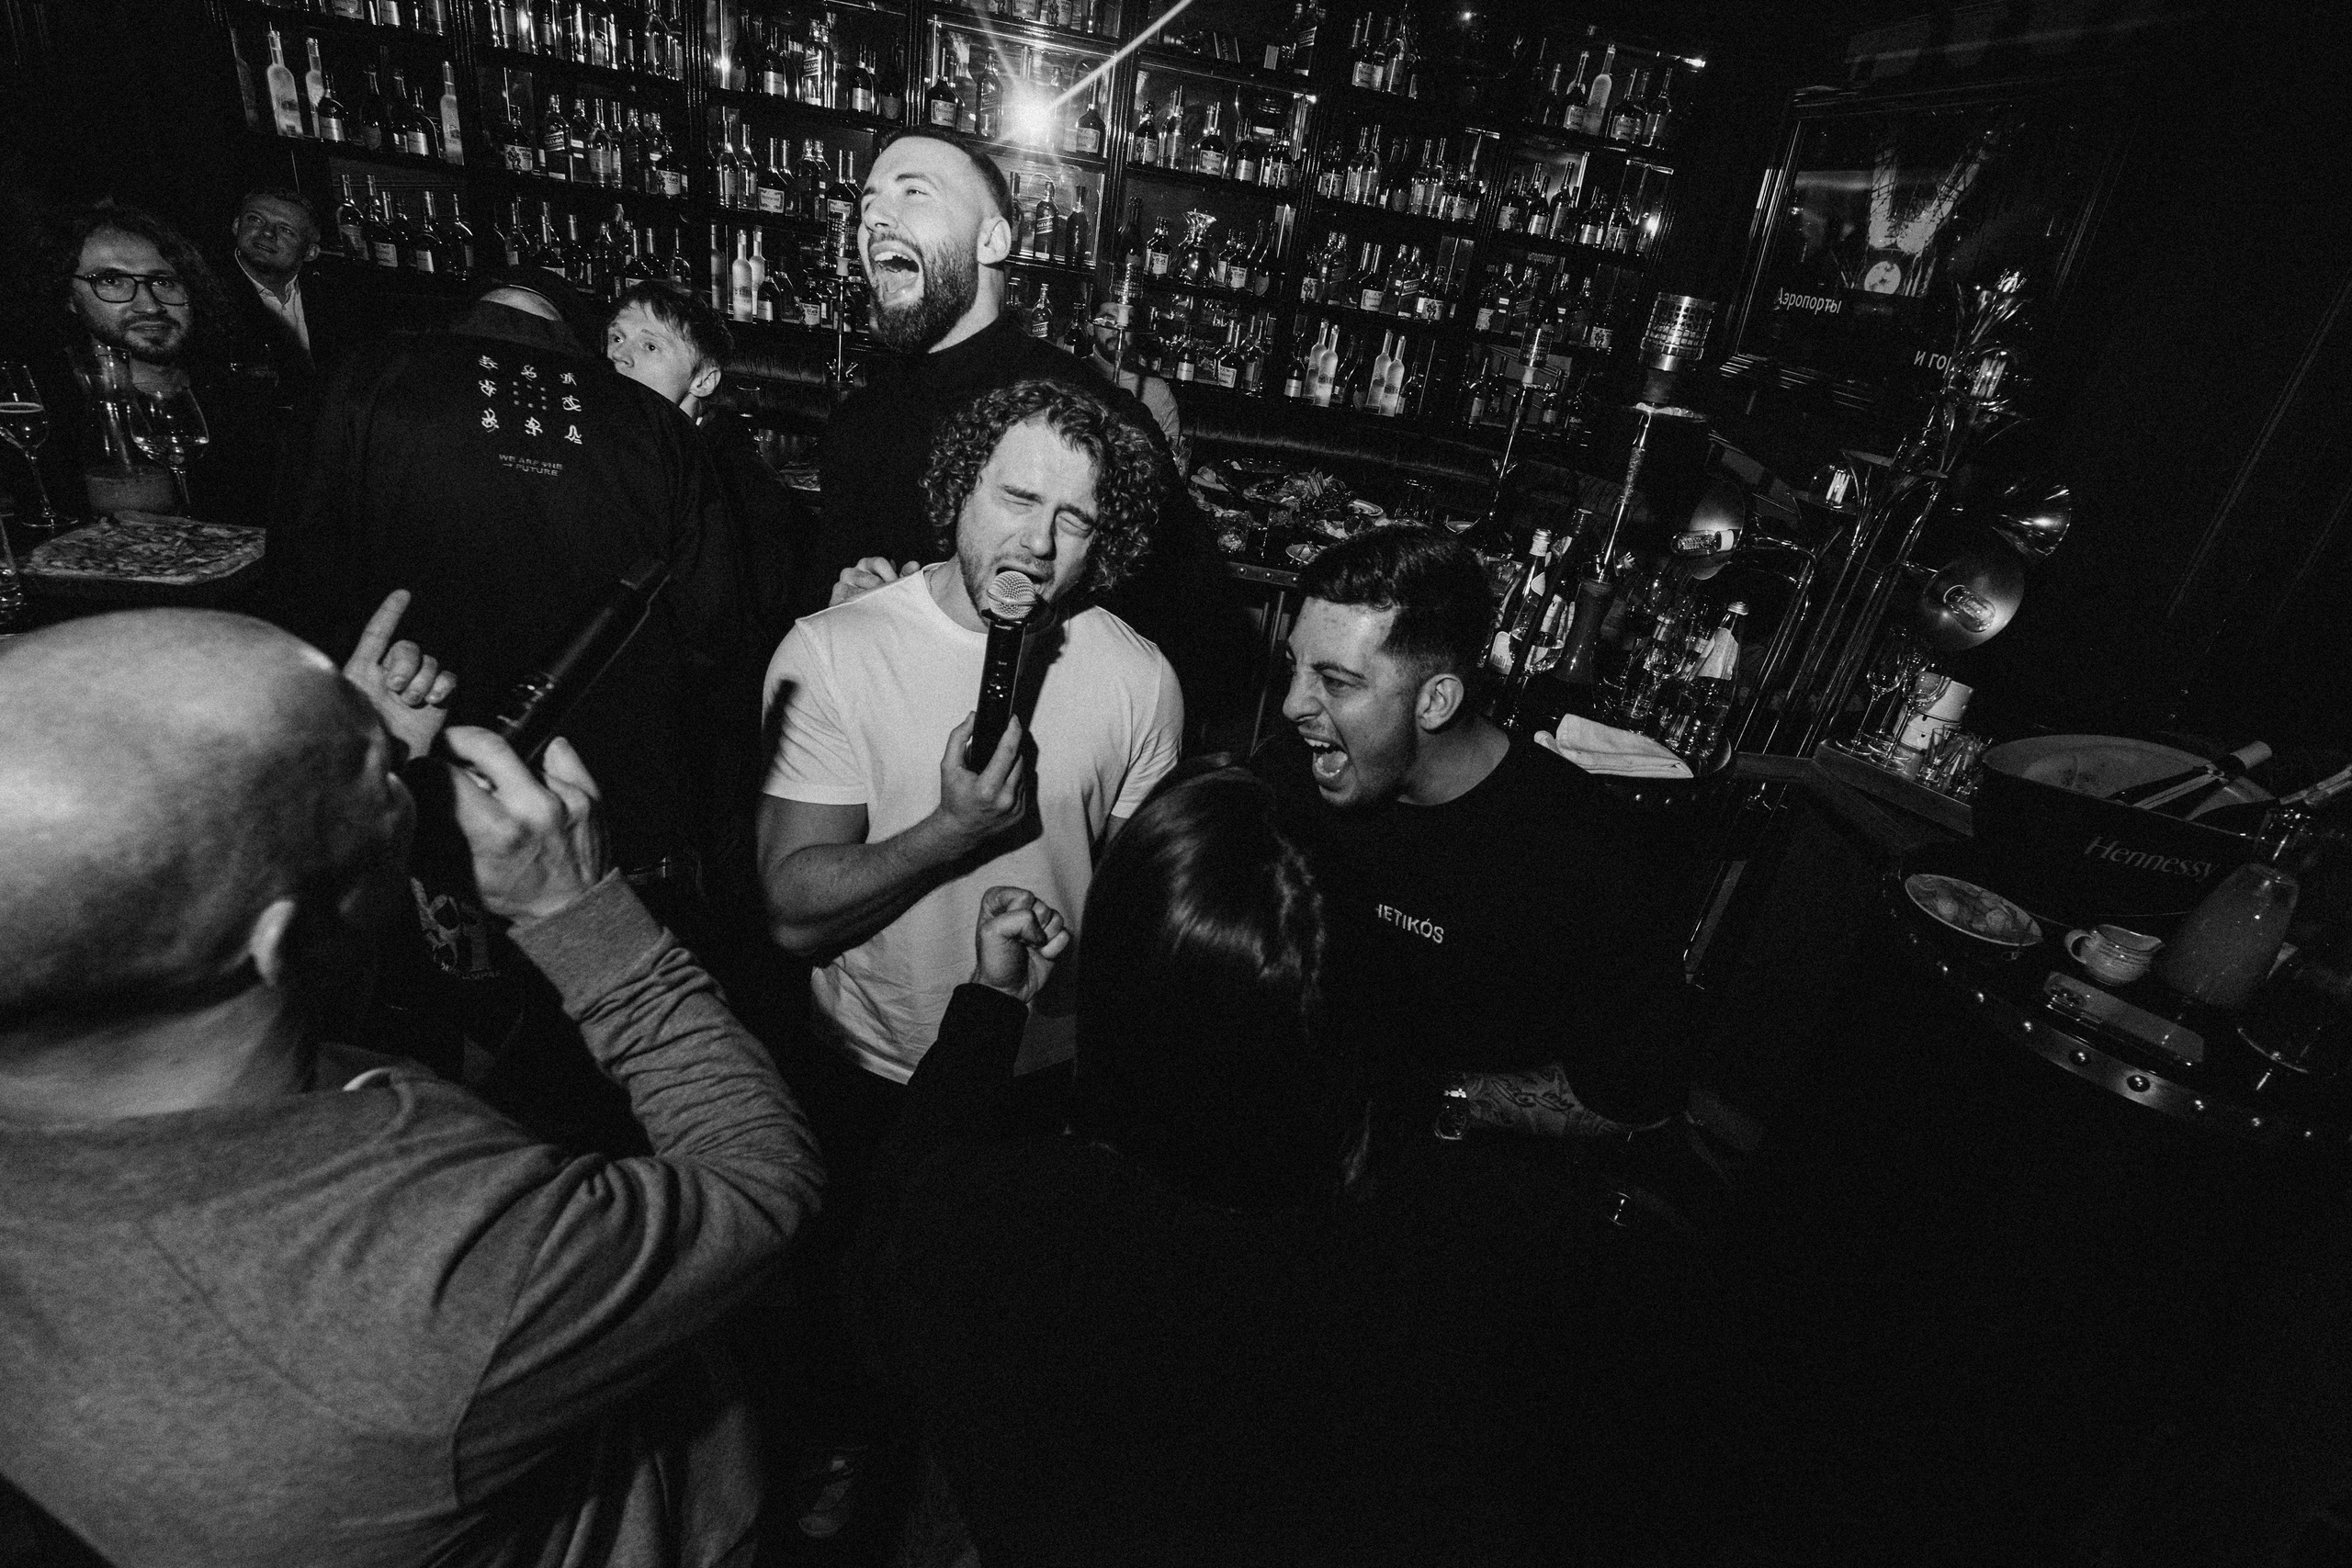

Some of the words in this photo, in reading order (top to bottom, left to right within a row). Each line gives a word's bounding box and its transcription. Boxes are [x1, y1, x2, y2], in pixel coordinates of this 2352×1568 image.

[498, 454, 516, 463] WE
[515, 464, 559, 476] FUTURE
[2084, 836, 2221, 883] Hennessy
